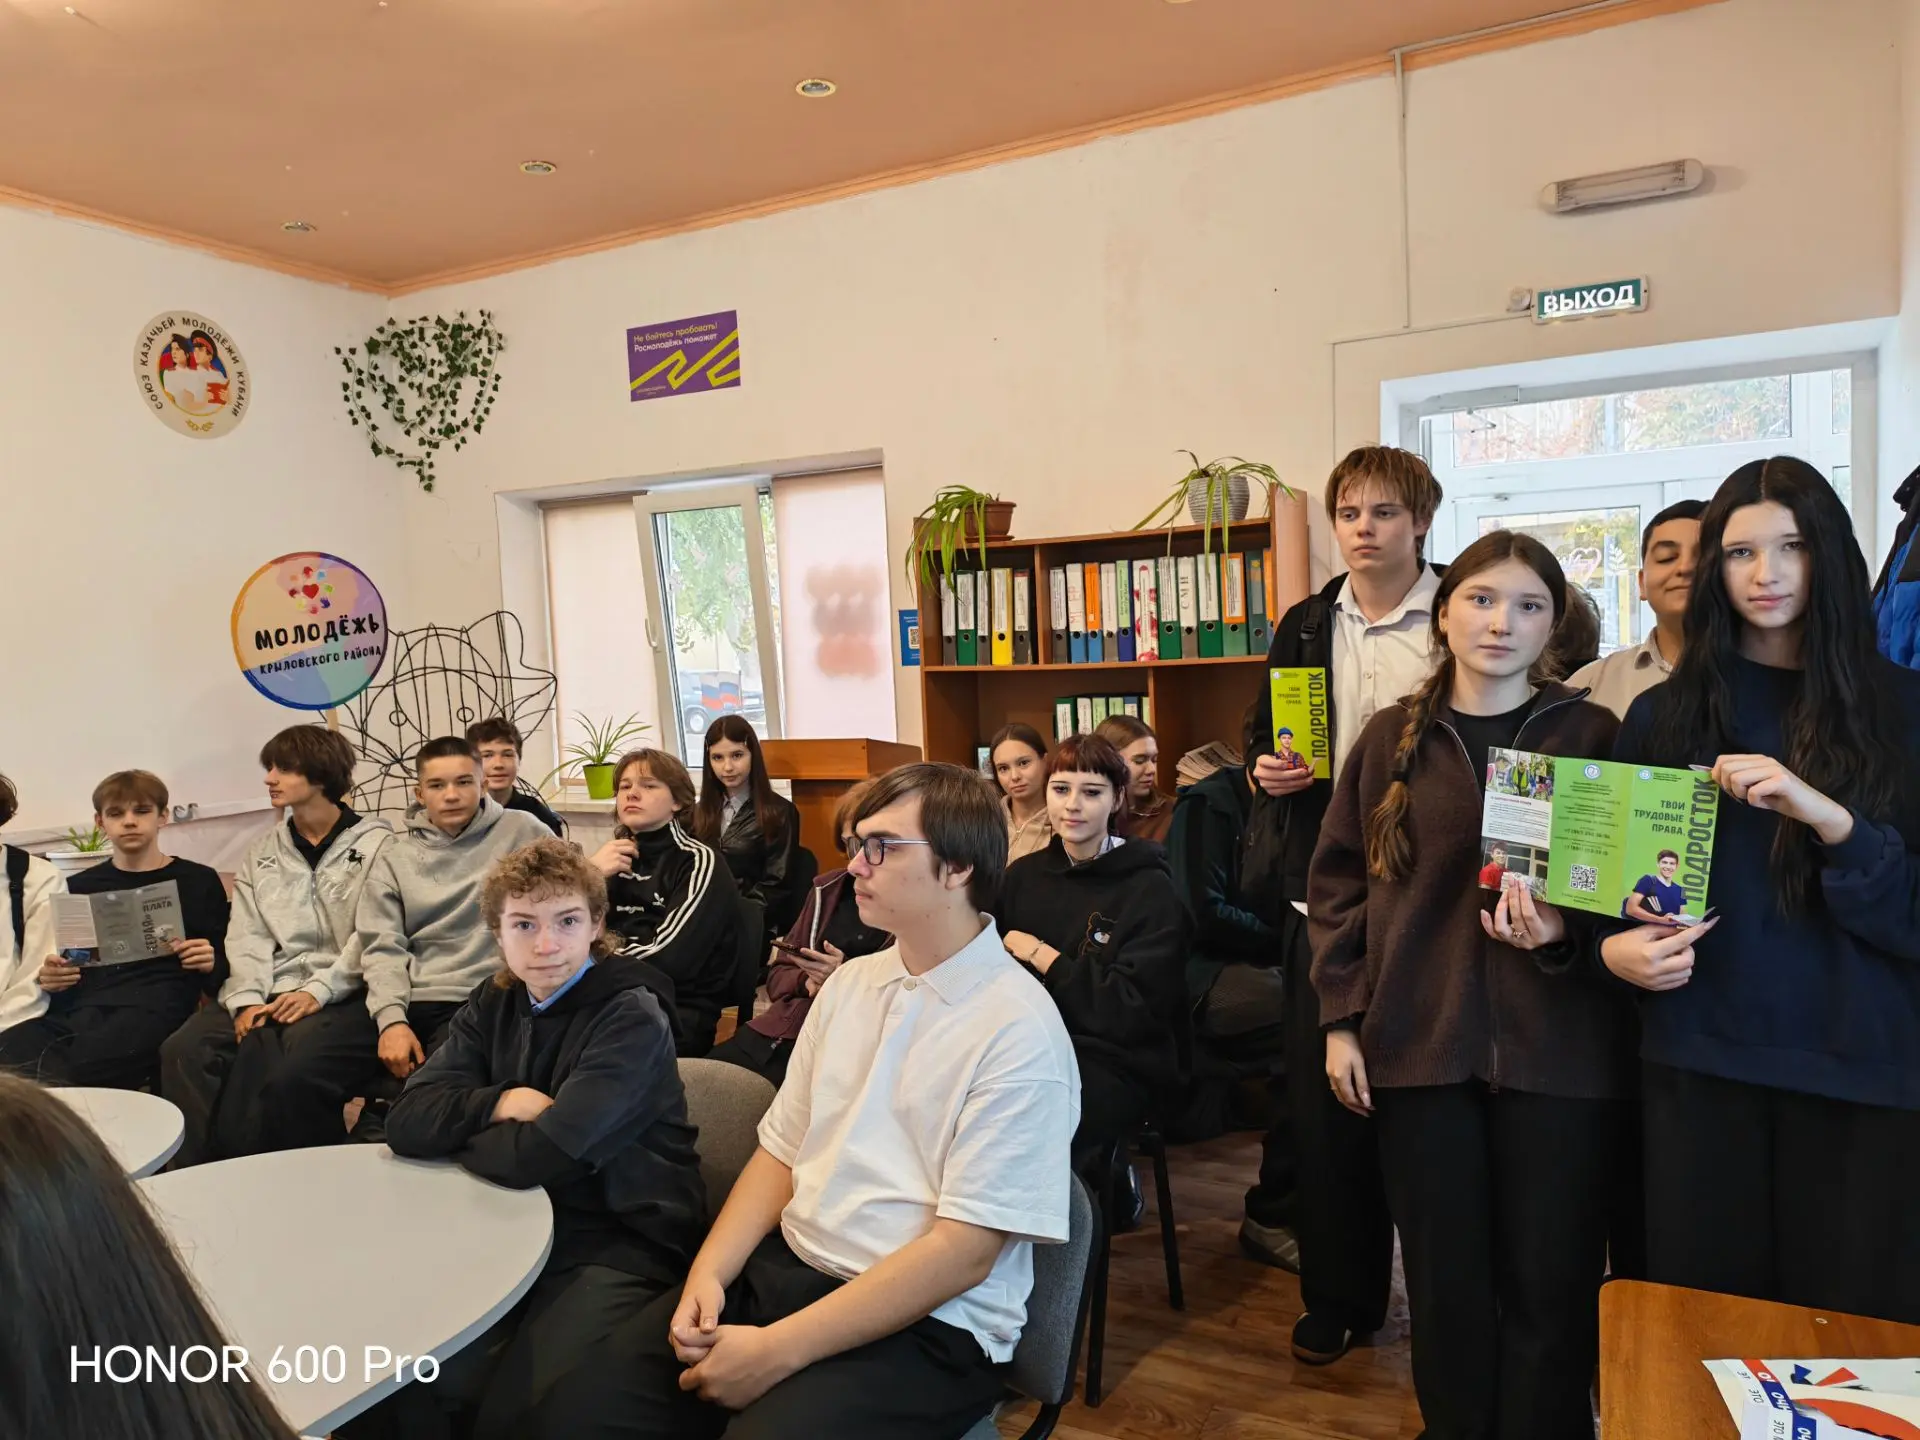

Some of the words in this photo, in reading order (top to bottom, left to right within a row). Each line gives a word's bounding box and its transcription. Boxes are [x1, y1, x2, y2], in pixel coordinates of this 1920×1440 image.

[1543, 284, 1636, 313] ВЫХОД
[140, 317, 176, 367] КАЗАЧЬЕЙ
[142, 374, 164, 410] СОЮЗ
[232, 371, 246, 417] КУБАНИ
[254, 613, 380, 650] МОЛОДЁЖЬ
[259, 652, 340, 675] КРЫЛОВСКОГО
[343, 646, 382, 661] РАЙОНА
[1308, 672, 1327, 758] ПОДРОСТОК
[1634, 809, 1685, 822] ТРУДОВЫЕ
[1660, 800, 1685, 810] ТВОИ
[1680, 777, 1718, 902] ПОДРОСТОК
[143, 900, 173, 912] ПЛАТА
